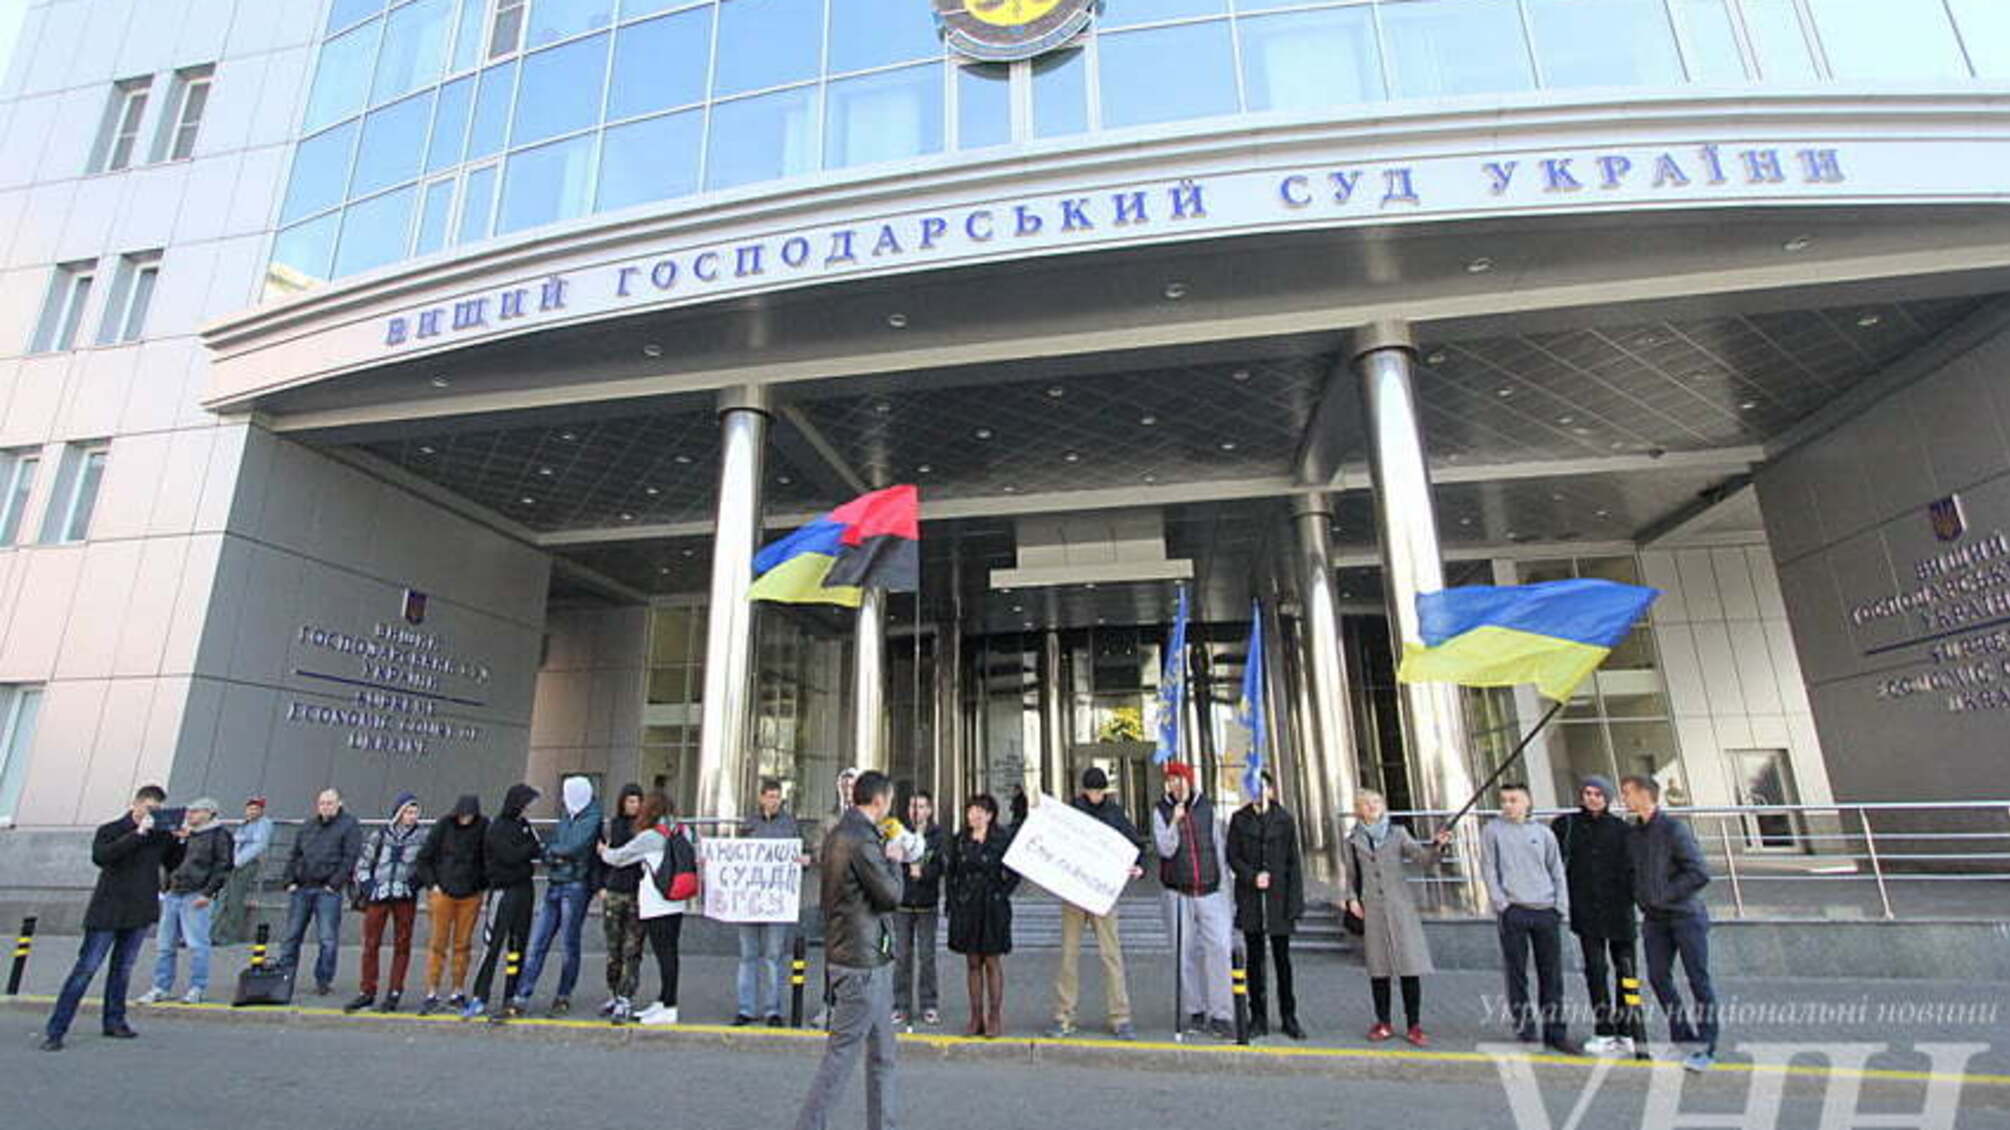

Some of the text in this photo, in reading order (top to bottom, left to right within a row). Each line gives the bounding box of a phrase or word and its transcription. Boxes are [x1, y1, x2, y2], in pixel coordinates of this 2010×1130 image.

[386, 143, 1846, 346] ВИЩИЙ ГОСПОДАРСЬКИЙ СУД УКРАЇНИ
